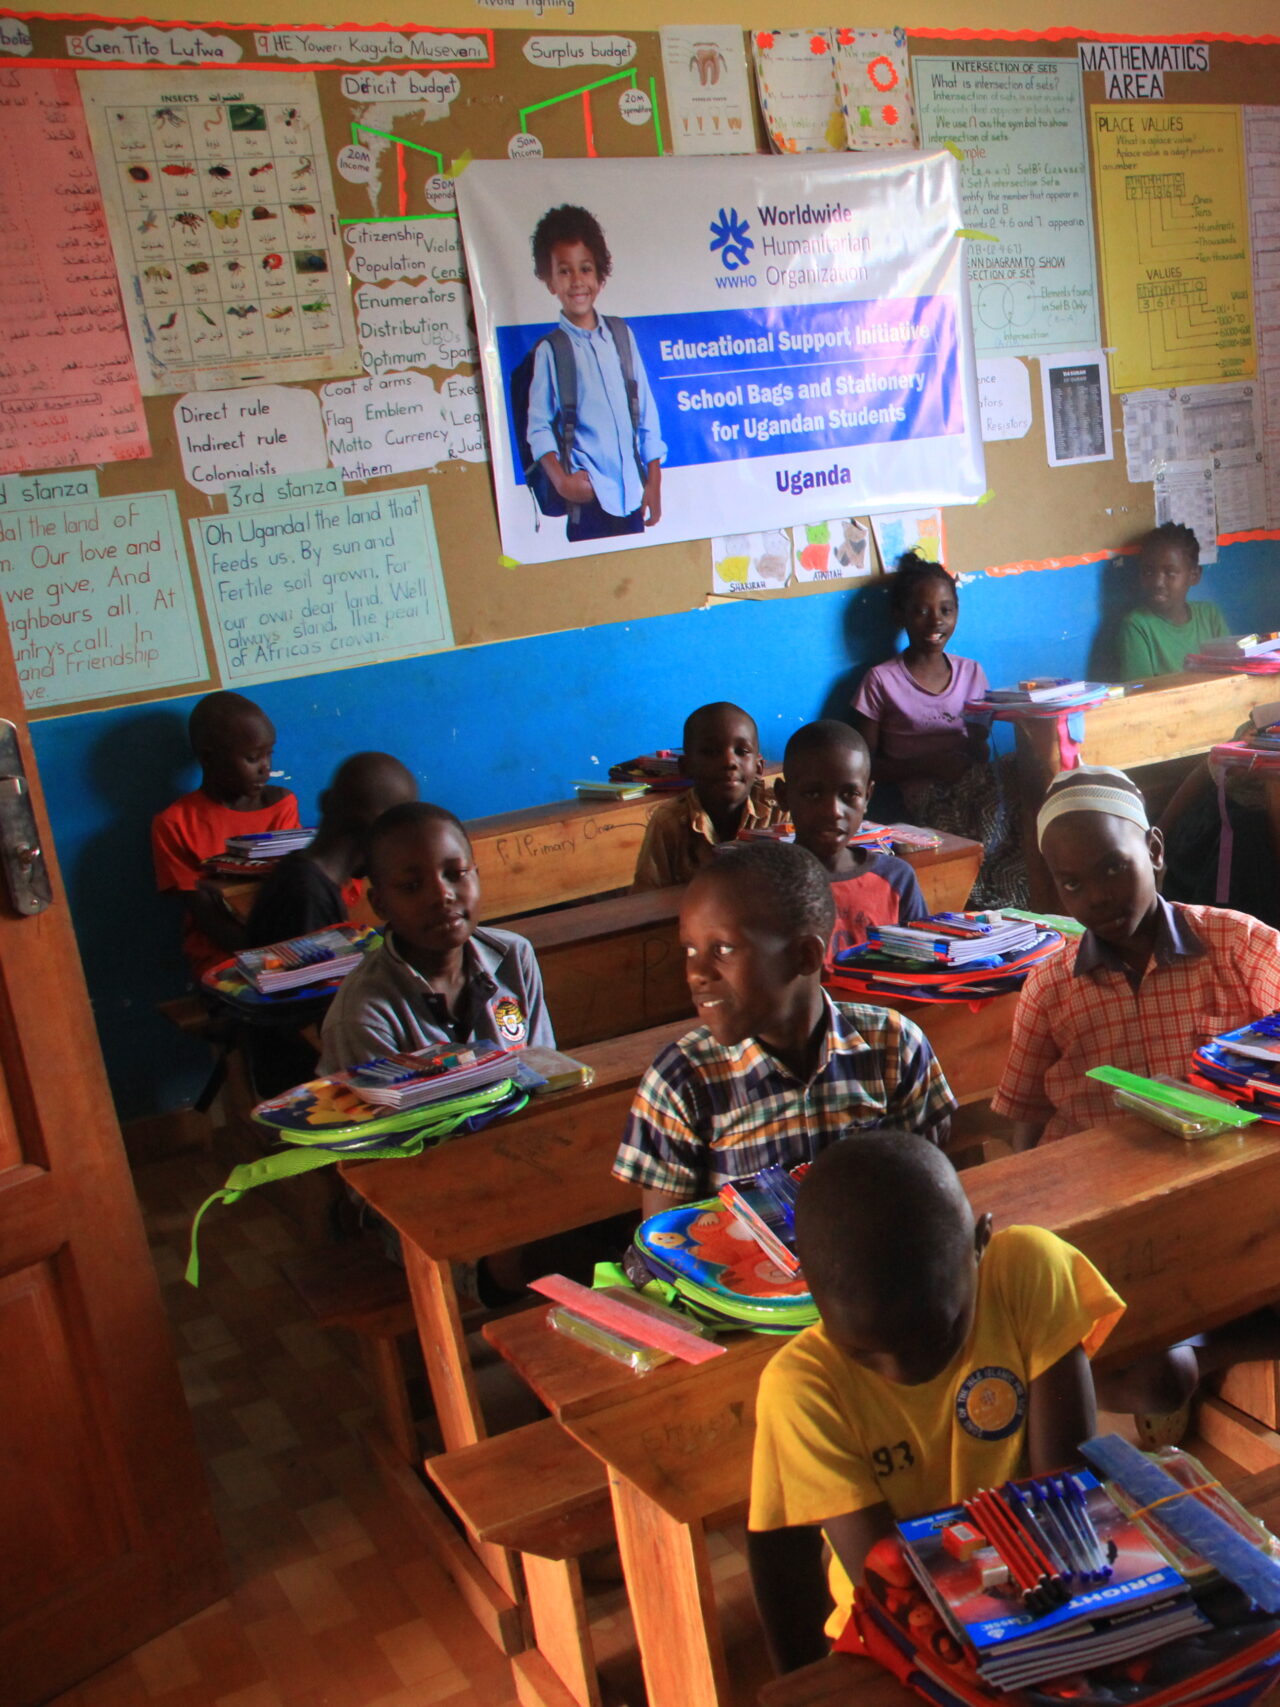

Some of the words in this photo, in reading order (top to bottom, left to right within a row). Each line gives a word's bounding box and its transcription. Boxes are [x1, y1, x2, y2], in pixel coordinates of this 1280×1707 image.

[71, 37, 84, 54] 8
[123, 36, 159, 56] Tito
[170, 37, 224, 58] Lutwa
[258, 36, 269, 53] 9
[296, 35, 342, 52] Yoweri
[350, 37, 403, 61] Kaguta
[410, 39, 481, 59] Museveni
[531, 41, 584, 67] Surplus
[591, 40, 632, 66] budget
[1080, 45, 1209, 72] MATHEMATICS
[952, 61, 1020, 73] INTERSECTION
[1023, 63, 1033, 72] OF
[1037, 64, 1058, 73] SETS
[345, 77, 397, 95] Deficit
[409, 77, 457, 103] budget
[931, 74, 957, 88] What
[963, 79, 972, 89] is
[974, 76, 1023, 90] intersection
[1025, 76, 1035, 90] of
[1036, 77, 1060, 91] sets?
[1109, 74, 1164, 98] AREA
[161, 94, 199, 103] INSECTS
[625, 94, 644, 104] 20M
[1100, 117, 1134, 132] PLACE
[1141, 116, 1184, 132] VALUES
[340, 155, 370, 172] Income
[347, 149, 371, 163] 20M
[511, 148, 542, 158] Income
[757, 203, 852, 226] Worldwide
[346, 227, 424, 246] Citizenship
[762, 232, 870, 257] Humanitarian
[355, 253, 426, 281] Population
[1039, 256, 1066, 268] SHOW
[1146, 267, 1183, 280] VALUES
[715, 275, 757, 289] WWHO
[766, 264, 869, 289] Organization
[358, 286, 456, 310] Enumerators
[361, 317, 448, 339] Distribution
[660, 332, 774, 362] Educational
[778, 325, 852, 354] Support
[856, 322, 930, 345] Initiative
[362, 351, 427, 376] Optimum
[324, 379, 356, 397] Coat
[363, 378, 373, 391] of
[379, 377, 412, 390] arms
[677, 385, 743, 411] School
[747, 381, 794, 407] Bags
[798, 377, 832, 398] and
[836, 372, 925, 396] Stationery
[181, 403, 227, 424] Direct
[240, 403, 270, 416] rule
[326, 410, 353, 433] Flag
[366, 403, 423, 421] Emblem
[712, 419, 739, 442] for
[744, 412, 825, 441] Ugandan
[828, 403, 906, 429] Students
[187, 431, 244, 453] Indirect
[258, 429, 288, 445] rule
[329, 438, 373, 456] Motto
[385, 429, 448, 447] Currency
[192, 461, 277, 482] Colonialists
[341, 462, 393, 480] Anthem
[776, 464, 852, 496] Uganda
[22, 480, 88, 502] stanza
[229, 482, 265, 508] 3rd
[277, 477, 337, 500] stanza
[28, 517, 56, 539] the
[63, 507, 99, 534] land
[114, 503, 140, 528] of
[206, 523, 233, 546] Oh
[315, 511, 340, 531] the
[347, 500, 381, 527] land
[388, 496, 419, 520] that
[31, 545, 69, 569] Our
[80, 540, 117, 562] love
[127, 530, 161, 556] and
[301, 540, 321, 567] By
[333, 541, 361, 556] sun
[365, 527, 395, 551] and
[6, 587, 34, 604] we
[107, 561, 151, 587] And
[218, 578, 272, 603] Fertile
[284, 568, 312, 593] soil
[385, 554, 408, 577] For
[154, 587, 176, 611] At
[224, 618, 245, 632] our
[259, 610, 293, 626] own
[301, 599, 335, 619] dear
[228, 628, 280, 651] always
[351, 608, 376, 629] The
[385, 600, 430, 629] pearl
[135, 622, 153, 642] In
[19, 658, 55, 681] and
[231, 649, 248, 668] of
[524, 833, 576, 857] Primary
[873, 1441, 914, 1476] 93
[1067, 1572, 1167, 1611] BRIGHT
